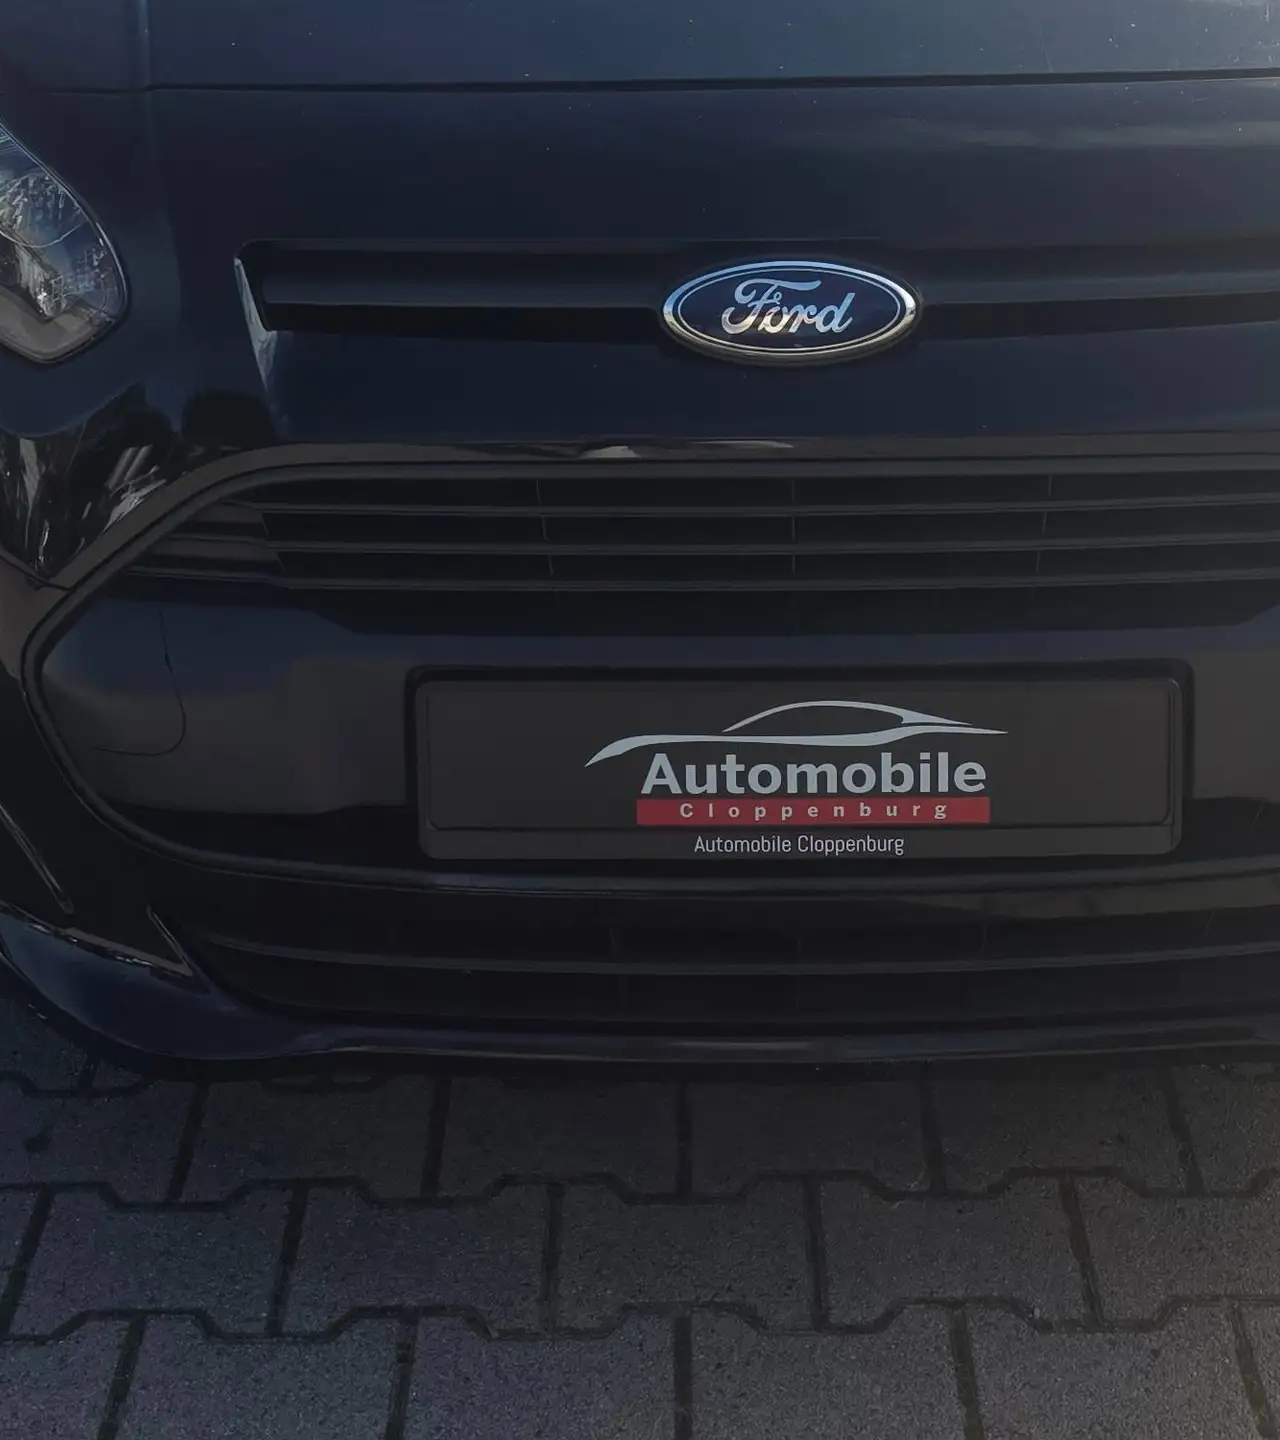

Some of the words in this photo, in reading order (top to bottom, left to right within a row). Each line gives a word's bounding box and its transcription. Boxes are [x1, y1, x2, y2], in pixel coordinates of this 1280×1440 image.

[721, 278, 856, 335] Ford
[640, 752, 987, 794] Automobile
[678, 801, 949, 821] Cloppenburg
[693, 834, 792, 853] Automobile
[796, 834, 905, 855] Cloppenburg
